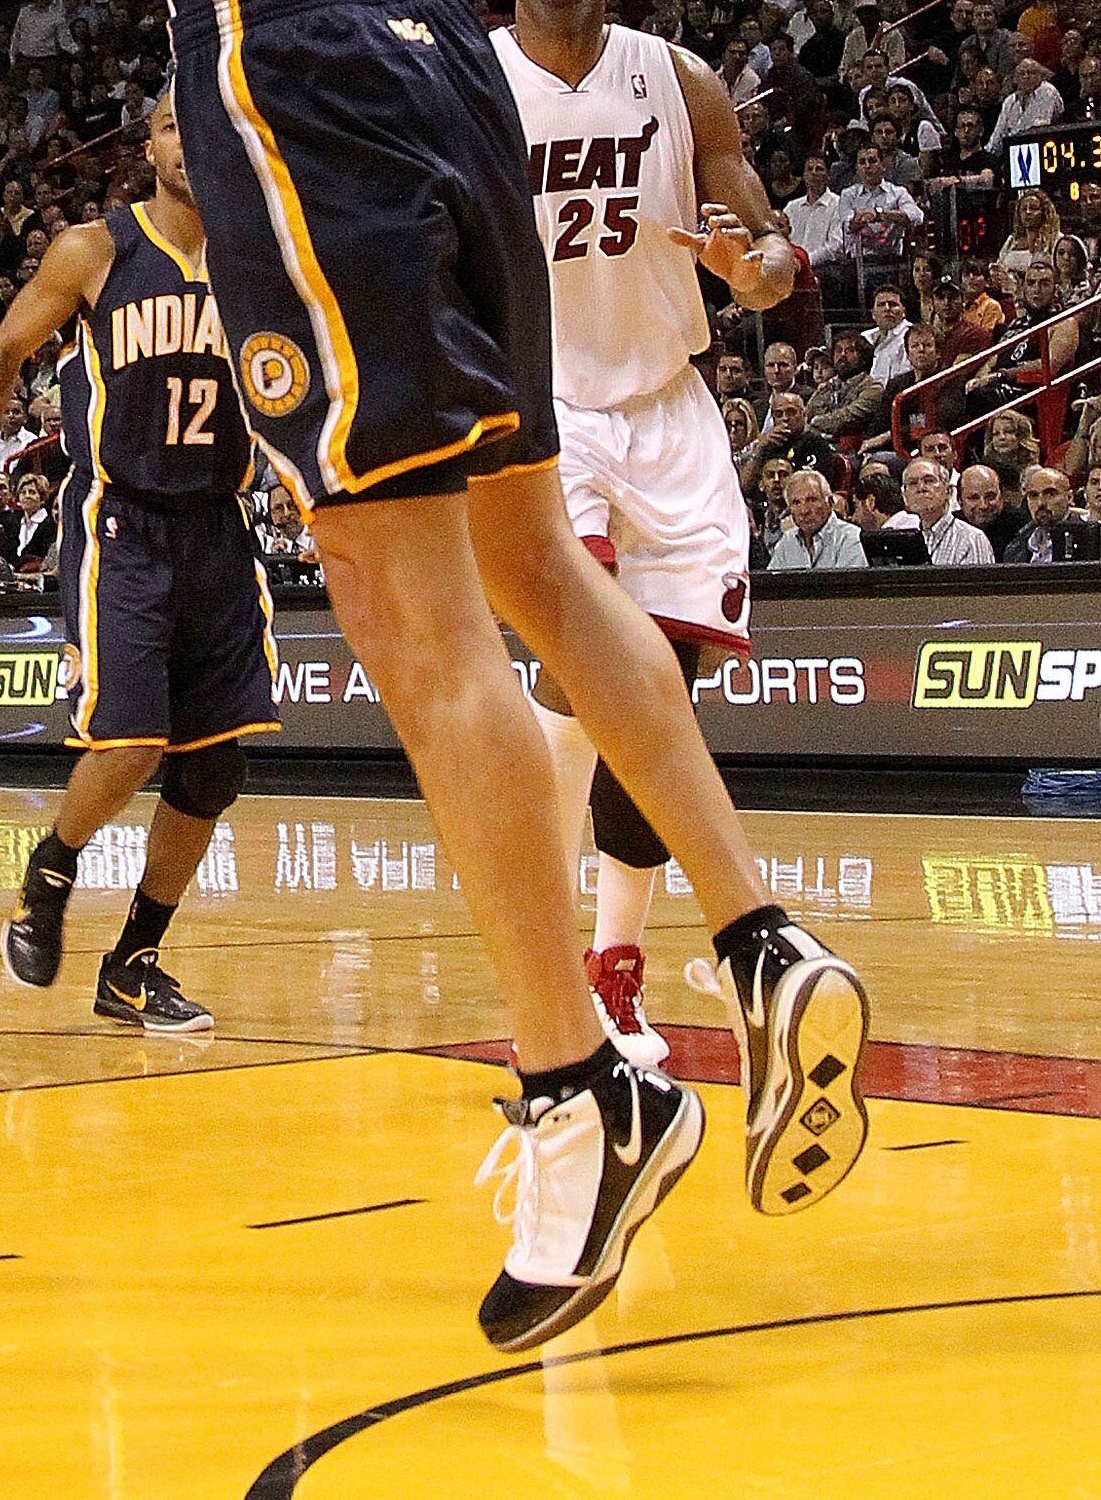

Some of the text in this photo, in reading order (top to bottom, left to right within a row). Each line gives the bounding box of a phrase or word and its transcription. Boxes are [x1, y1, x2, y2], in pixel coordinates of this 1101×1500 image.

[552, 195, 640, 262] 25
[111, 293, 229, 371] INDIA
[165, 376, 219, 446] 12
[271, 661, 381, 704] WE A
